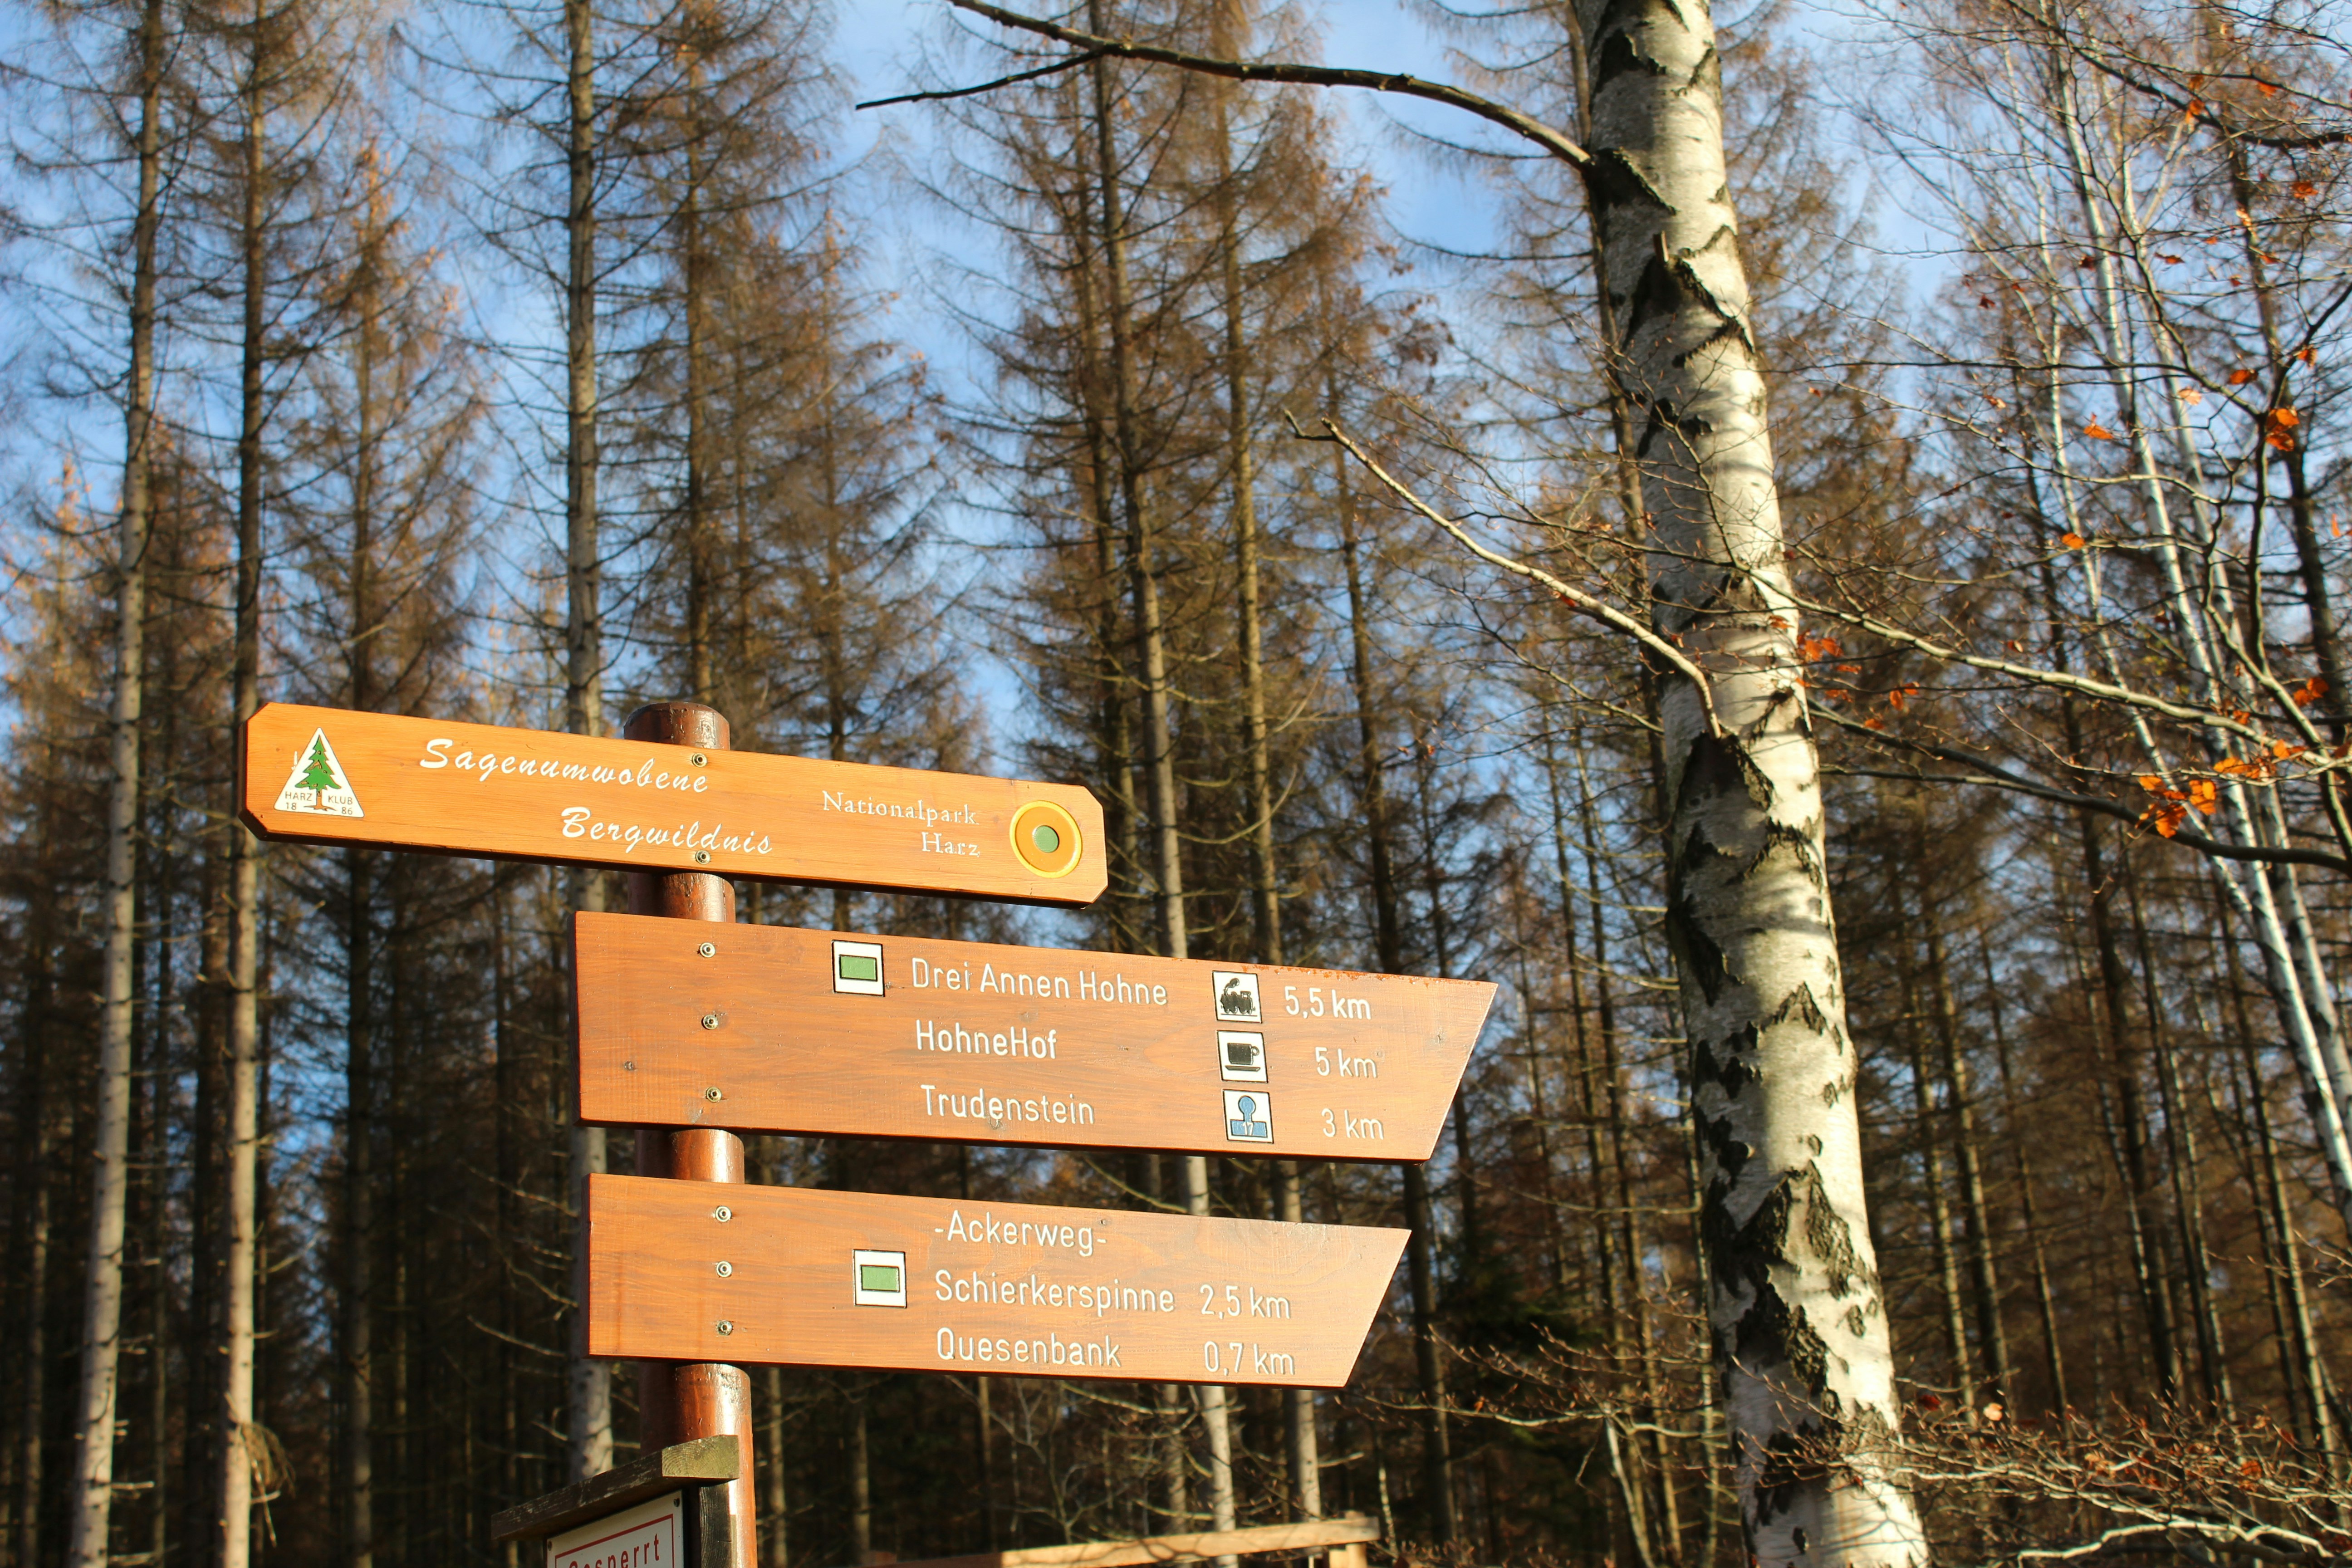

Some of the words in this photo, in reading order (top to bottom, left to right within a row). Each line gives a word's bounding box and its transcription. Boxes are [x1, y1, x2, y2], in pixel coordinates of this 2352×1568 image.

[419, 738, 708, 793] Sagenumwobene
[285, 791, 313, 802] HARZ
[328, 795, 353, 805] KLUB
[286, 802, 297, 810] 18
[341, 807, 353, 815] 86
[822, 790, 980, 828] Nationalpark
[561, 806, 773, 855] Bergwildnis
[921, 831, 980, 856] Harz
[911, 957, 970, 990] Drei
[980, 963, 1070, 999] Annen
[1079, 970, 1167, 1005] Hohne
[1284, 985, 1324, 1019] 5,5
[1331, 989, 1372, 1020] km
[916, 1019, 1057, 1059] HohneHof
[1315, 1046, 1330, 1076] 5
[1337, 1048, 1377, 1078] km
[920, 1084, 1094, 1126] Trudenstein
[1321, 1107, 1336, 1137] 3
[1344, 1109, 1384, 1140] km
[934, 1210, 1106, 1257] -Ackerweg-
[935, 1269, 1174, 1318] Schierkerspinne
[1200, 1284, 1240, 1319] 2,5
[1249, 1286, 1290, 1319] km
[937, 1327, 1121, 1367] Quesenbank
[1204, 1340, 1243, 1376] 0,7
[1253, 1343, 1294, 1375] km
[569, 1533, 659, 1568] errt
